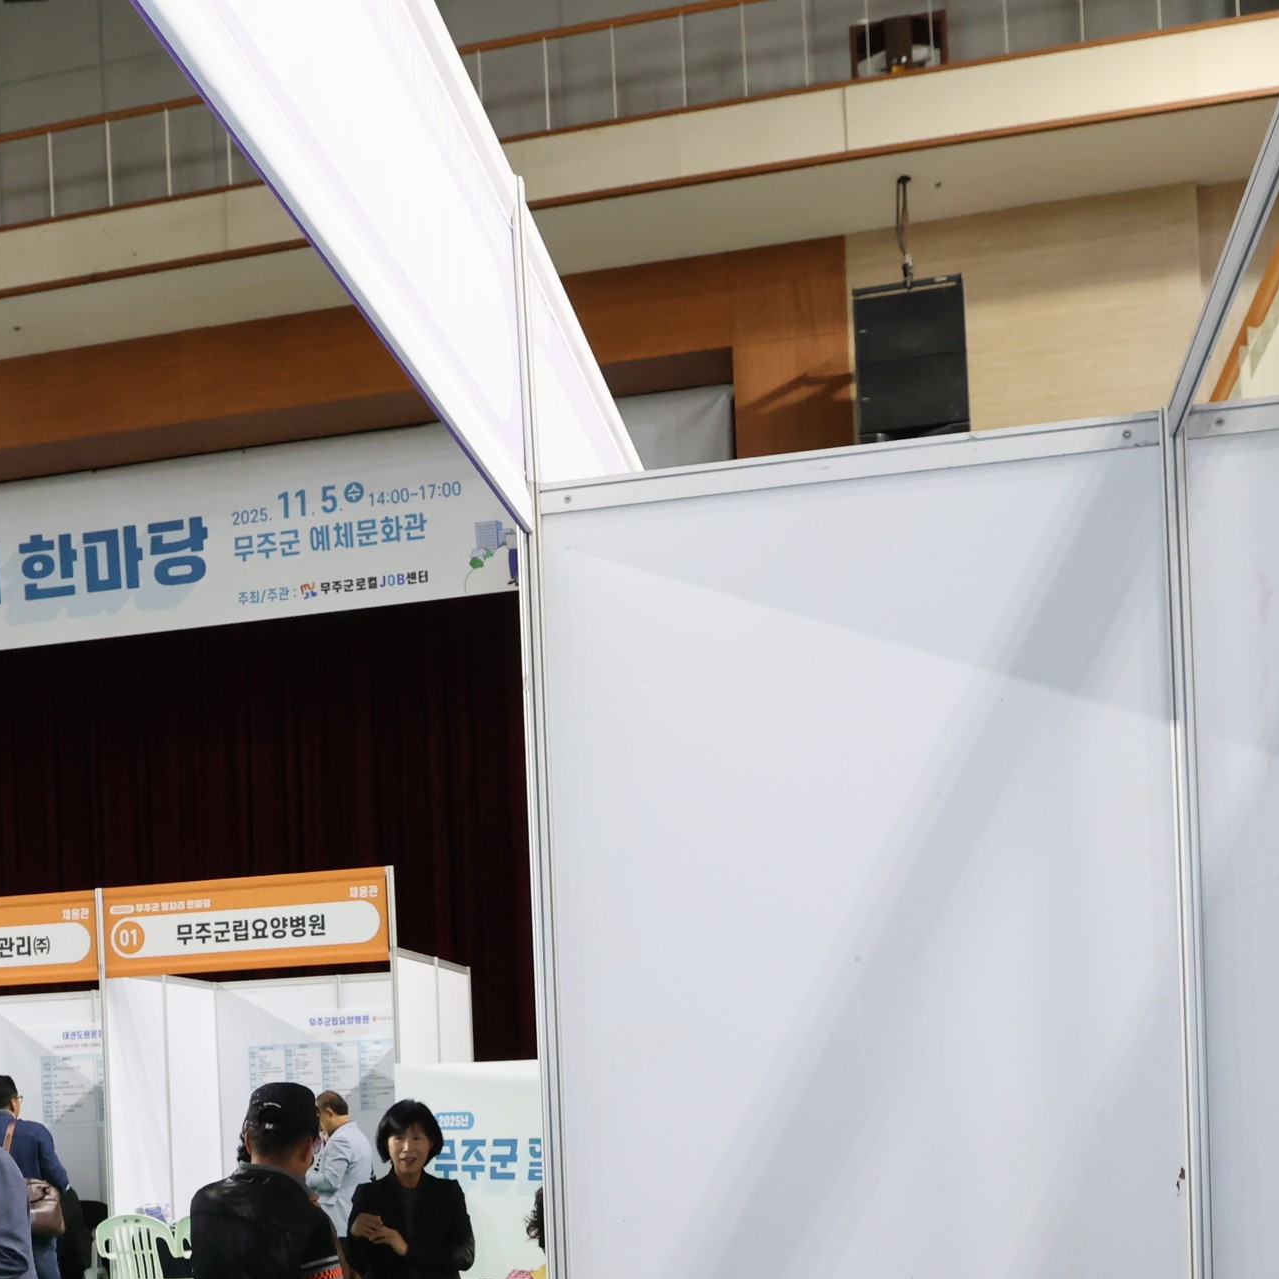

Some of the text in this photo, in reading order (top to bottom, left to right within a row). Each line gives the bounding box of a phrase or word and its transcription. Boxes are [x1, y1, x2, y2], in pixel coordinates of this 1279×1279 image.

[231, 508, 272, 526] 2025.
[368, 481, 462, 507] 14:00~17:00
[18, 516, 209, 601] 한마당
[233, 512, 427, 562] 무주군 예체문화관
[119, 929, 138, 947] 01
[177, 913, 327, 946] 무주군립요양병원
[438, 1115, 469, 1128] 2025년
[434, 1138, 518, 1181] 무주군
